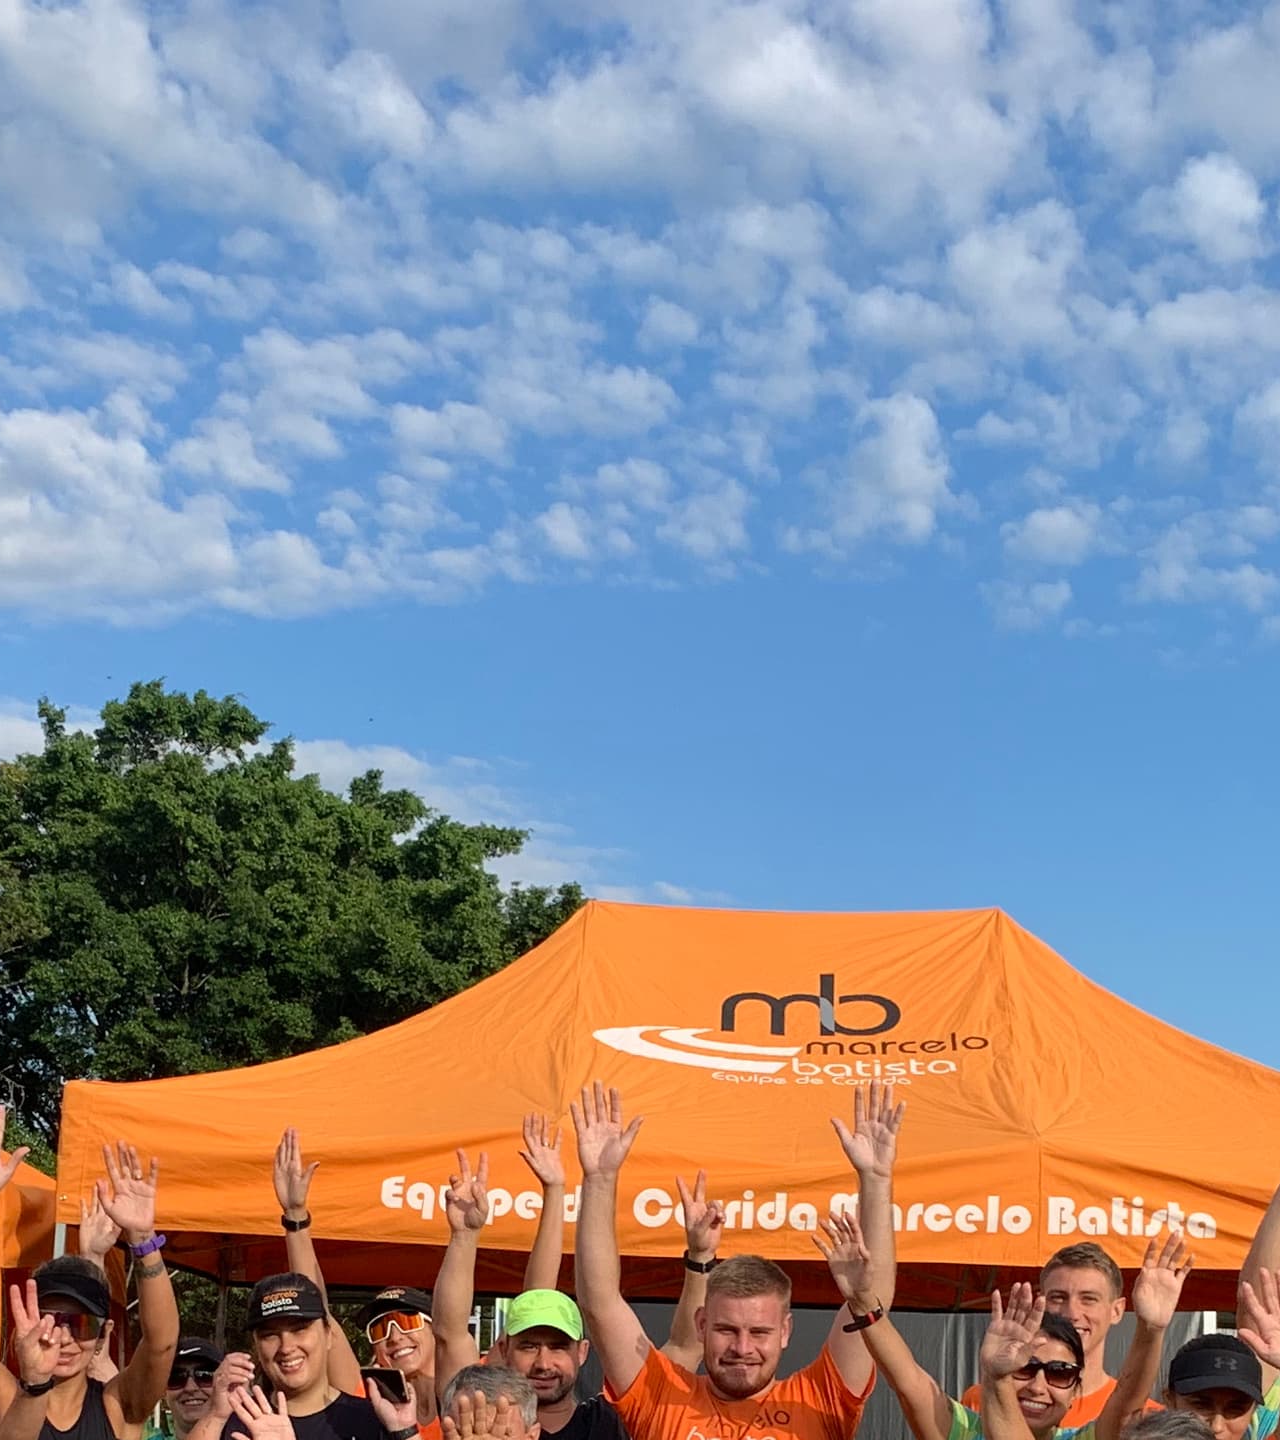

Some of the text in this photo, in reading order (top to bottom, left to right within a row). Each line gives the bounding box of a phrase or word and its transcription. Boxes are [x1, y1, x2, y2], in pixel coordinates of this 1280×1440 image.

[806, 1032, 989, 1056] marcelo
[792, 1057, 957, 1077] batista
[795, 1075, 824, 1085] de
[381, 1175, 543, 1226] Eqpe
[633, 1188, 817, 1231] Crida
[1047, 1196, 1217, 1239] Batista
